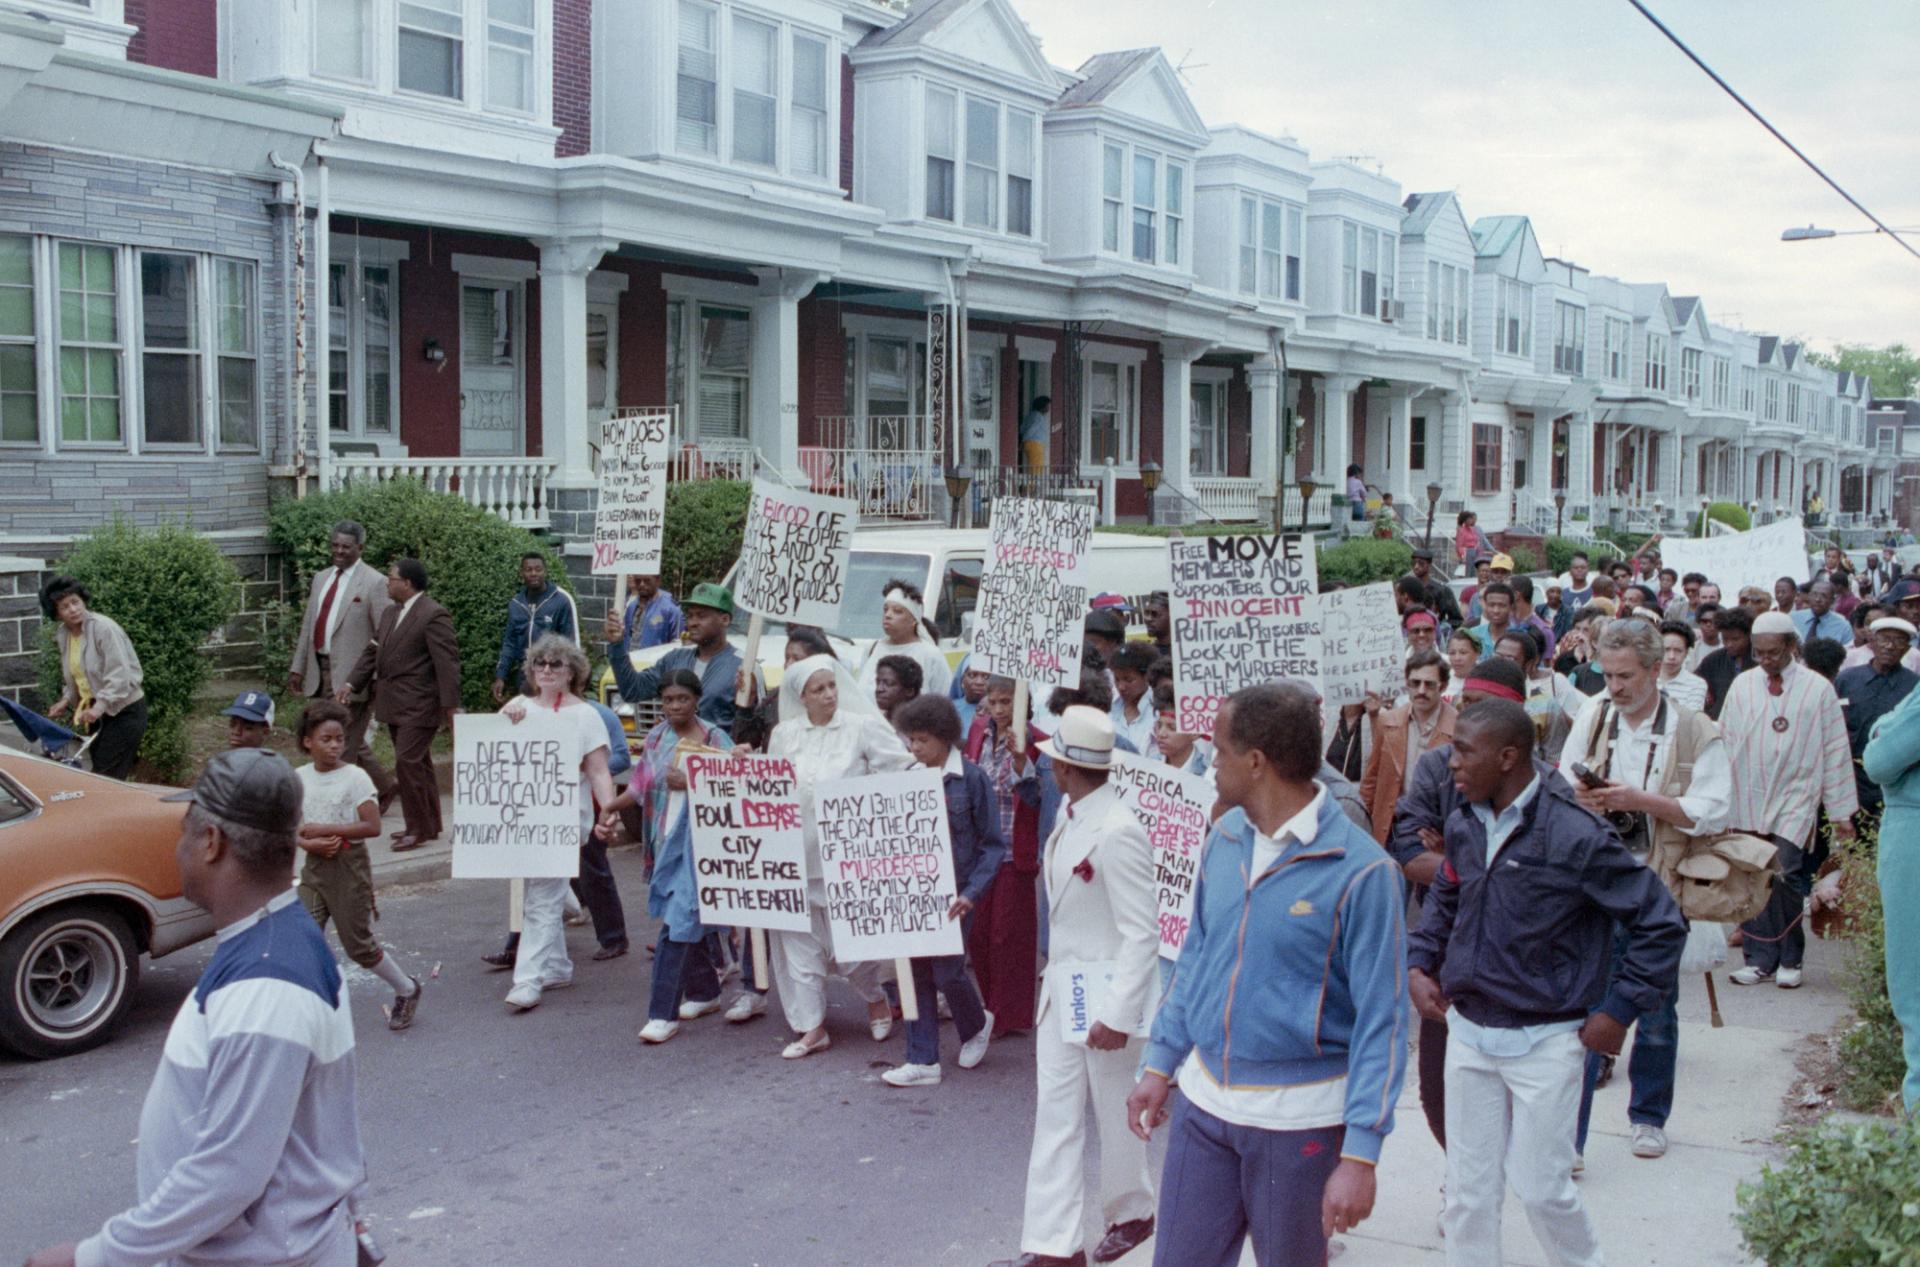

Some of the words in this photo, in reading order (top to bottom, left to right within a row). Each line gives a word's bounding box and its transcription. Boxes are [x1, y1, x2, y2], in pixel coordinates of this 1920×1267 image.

[602, 420, 627, 445] HOW
[631, 419, 665, 443] DOES
[627, 443, 646, 455] FEEL
[816, 511, 846, 530] OF
[1028, 501, 1039, 517] IS
[1041, 503, 1058, 521] NO
[1062, 503, 1091, 525] SUCH
[638, 525, 661, 539] THAT
[1028, 516, 1041, 535] AS
[1046, 519, 1092, 540] FREEDOM
[593, 542, 616, 569] YOU
[779, 542, 815, 562] AND
[996, 543, 1076, 570] OPPRESSED
[1073, 538, 1085, 555] IN
[1170, 541, 1206, 561] FREE
[1208, 535, 1303, 561] MOVE
[812, 562, 839, 586] ON
[993, 560, 1060, 584] AMERICA
[1172, 560, 1255, 582] MEMBERS
[1260, 558, 1303, 578] AND
[1271, 577, 1313, 596] OUR
[1057, 601, 1082, 621] AND
[1186, 596, 1304, 619] INNOCENT
[1029, 650, 1061, 670] REAL
[1256, 638, 1306, 658] THE
[988, 653, 1068, 686] TERRORIST
[1179, 662, 1222, 682] REAL
[1225, 660, 1318, 680] MURDERERS
[244, 693, 257, 705] B
[1180, 696, 1229, 713] GOO
[1180, 712, 1216, 732] BRO
[477, 740, 560, 765] NEVER
[456, 762, 523, 783] FORGET
[533, 762, 566, 784] THE
[686, 755, 796, 790] PHILADELPHIA
[458, 782, 577, 806] HOLOCAUST
[708, 780, 736, 797] THE
[748, 780, 792, 796] MOST
[501, 804, 529, 827] OF
[695, 802, 742, 828] FOUL
[741, 798, 802, 832] DEBASE
[823, 795, 864, 819] MAY
[870, 793, 896, 815] 13TH
[900, 790, 938, 814] 1985
[1138, 788, 1205, 829] COWARD
[453, 824, 503, 845] MONDAY
[506, 824, 537, 845] MAY
[818, 820, 846, 841] THE
[850, 818, 874, 838] DAY
[877, 816, 904, 835] THE
[905, 812, 938, 834] CITY
[722, 836, 761, 864] CITY
[822, 843, 837, 861] OF
[843, 835, 944, 860] PHILADELPHIA
[698, 858, 722, 875] ON
[722, 860, 758, 880] THE
[762, 861, 801, 880] FACE
[839, 854, 938, 880] MURDERED
[1162, 850, 1195, 875] MAN
[827, 882, 856, 901] OUR
[860, 876, 911, 900] FAMILY
[917, 874, 940, 893] BY
[1154, 864, 1192, 895] TRUTH
[701, 886, 723, 910] OF
[724, 888, 757, 910] THE
[884, 895, 907, 915] AND
[1159, 888, 1184, 909] PUT
[847, 916, 885, 936] THEM
[1070, 973, 1087, 1031] kinko's
